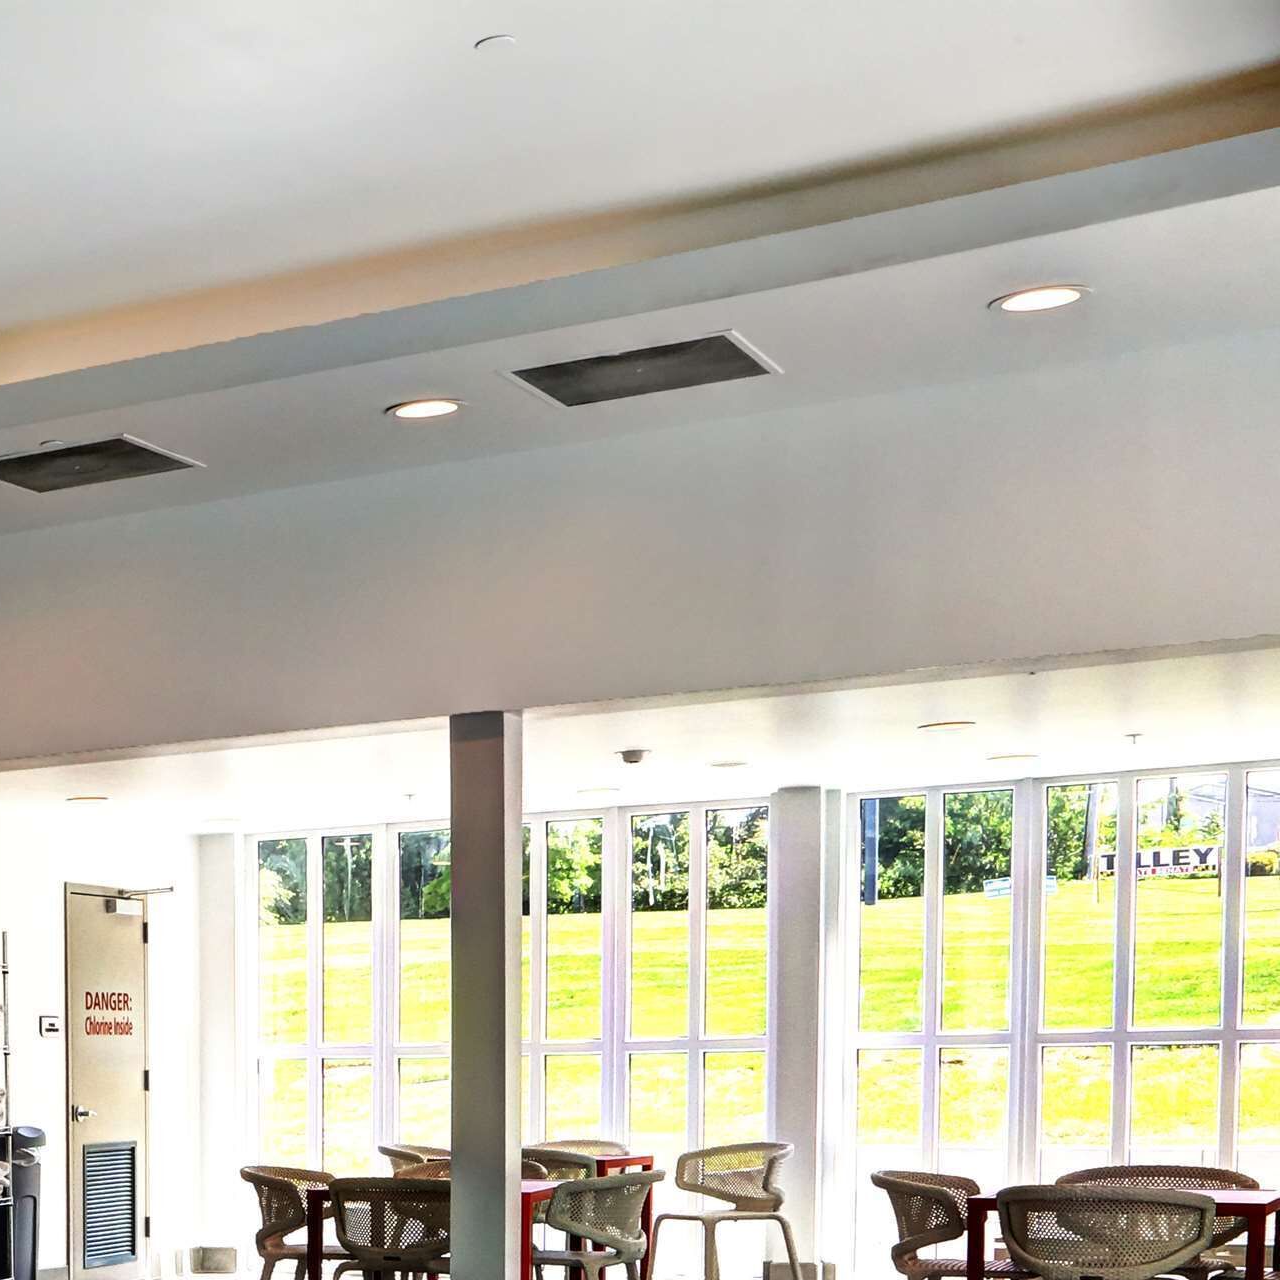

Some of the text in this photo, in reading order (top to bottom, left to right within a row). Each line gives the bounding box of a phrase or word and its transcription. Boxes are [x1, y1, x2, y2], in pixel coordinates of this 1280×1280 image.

[1101, 847, 1213, 870] TLLEY
[85, 991, 132, 1011] DANGER:
[85, 1016, 133, 1035] Chlorine Inside
